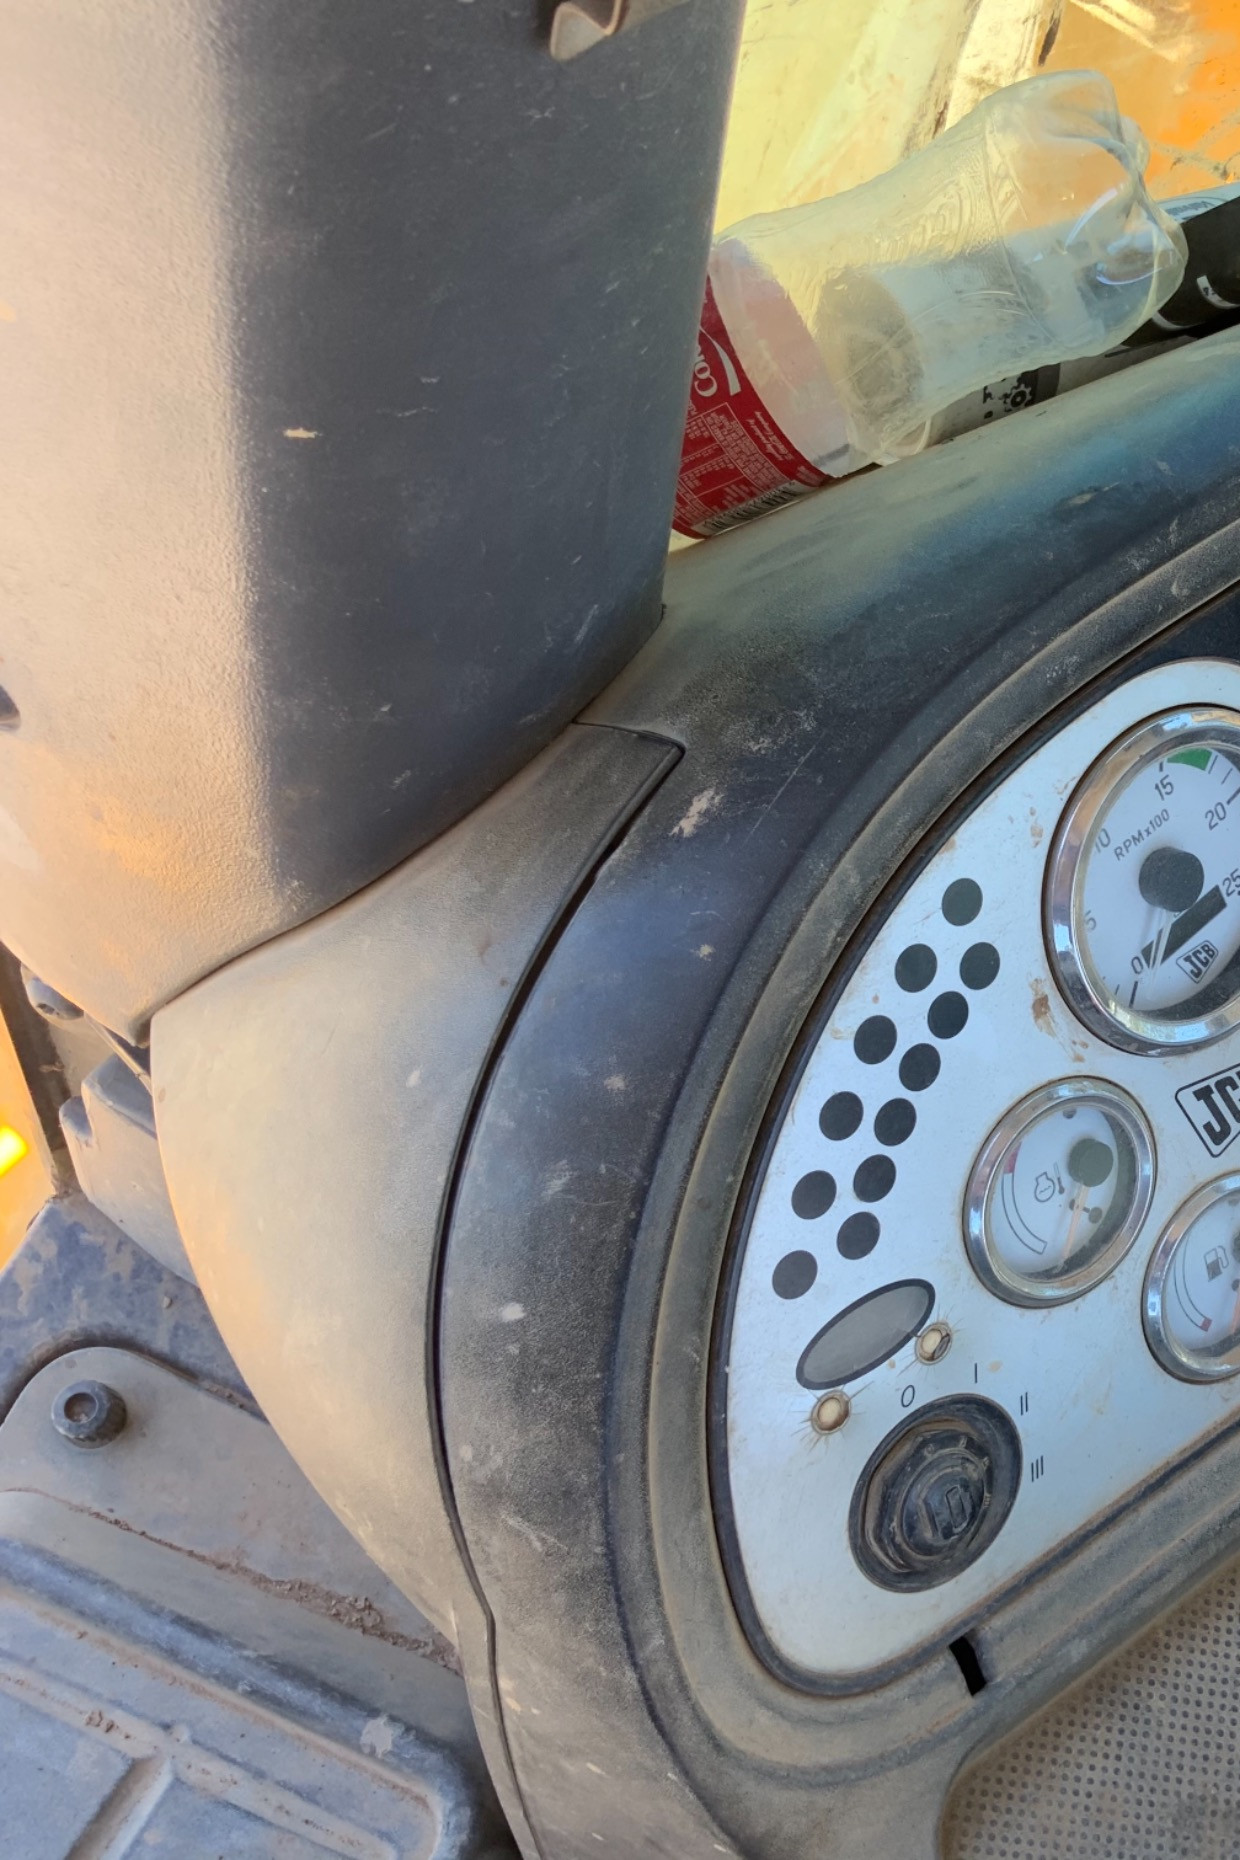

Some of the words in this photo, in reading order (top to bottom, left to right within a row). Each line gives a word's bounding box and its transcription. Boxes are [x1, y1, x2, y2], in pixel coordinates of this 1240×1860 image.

[1154, 774, 1174, 801] 15
[1205, 801, 1227, 830] 20
[1130, 956, 1144, 976] 0
[1187, 943, 1215, 979] JCB
